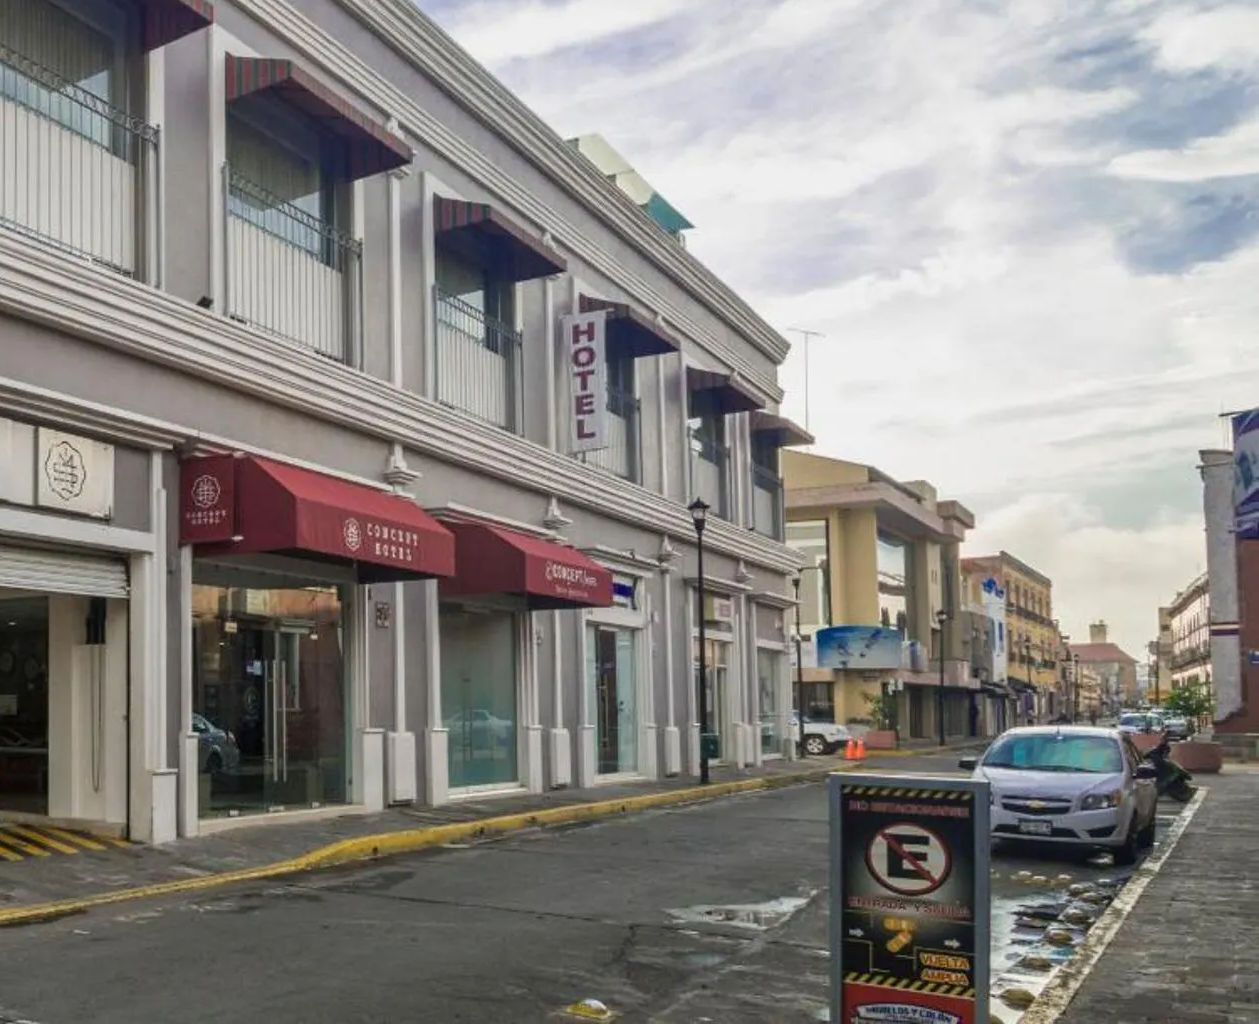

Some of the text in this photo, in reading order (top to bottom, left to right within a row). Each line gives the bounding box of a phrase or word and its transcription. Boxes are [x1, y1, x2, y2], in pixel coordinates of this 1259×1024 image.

[572, 321, 596, 440] HOTEL
[367, 523, 418, 547] CONCEPT
[375, 542, 412, 561] HOTEL
